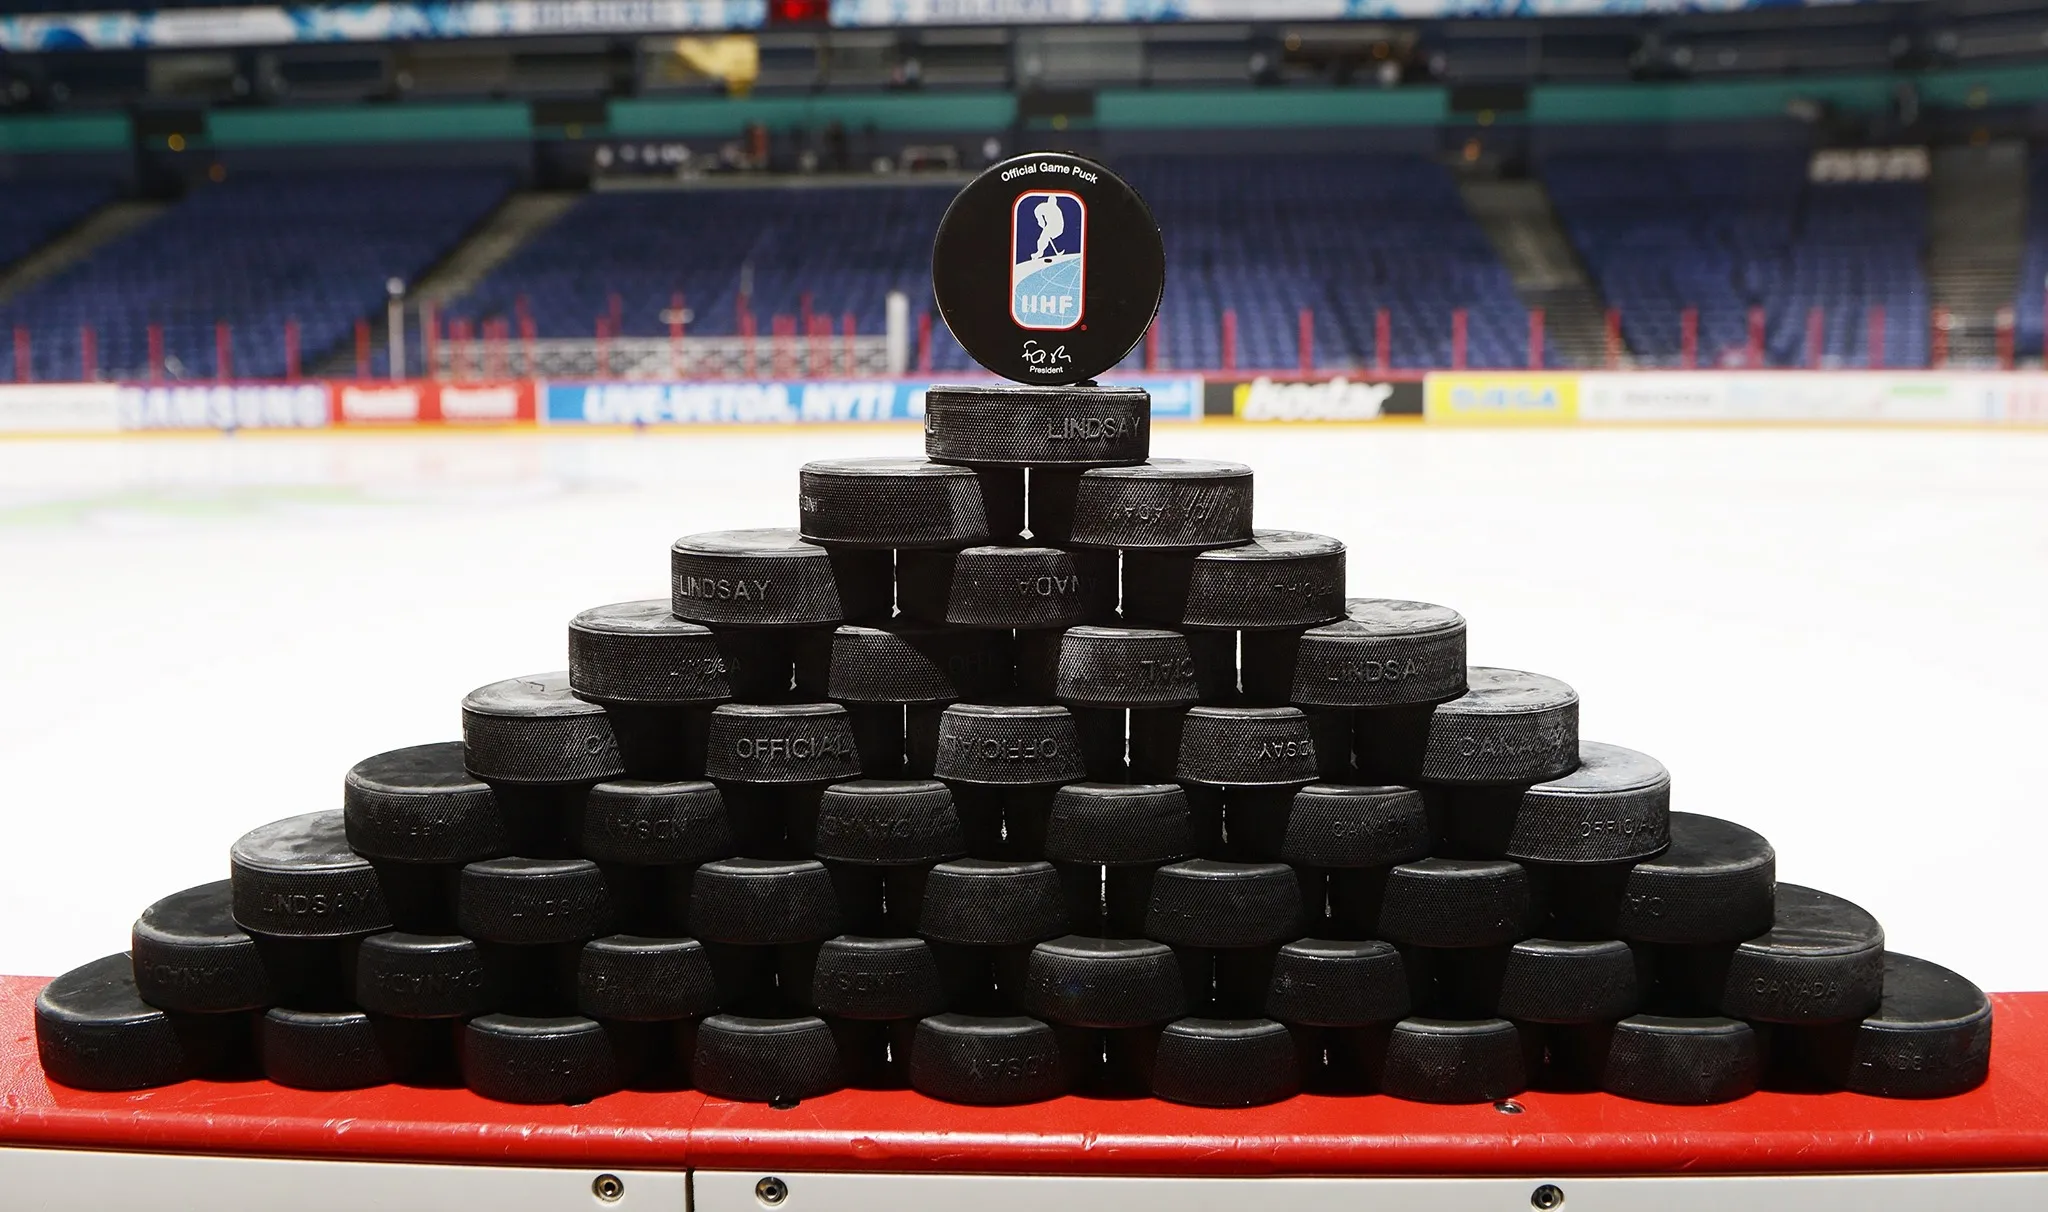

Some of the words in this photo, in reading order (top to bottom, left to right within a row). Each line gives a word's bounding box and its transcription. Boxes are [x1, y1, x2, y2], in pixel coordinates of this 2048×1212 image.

[1001, 163, 1037, 182] Official
[1039, 162, 1070, 175] Game
[1072, 166, 1099, 184] Puck
[1021, 295, 1073, 314] IIHF
[1029, 366, 1064, 374] President
[1047, 416, 1142, 439] LINDSAY
[679, 575, 771, 600] LINDSAY
[736, 735, 850, 759] OFFICIAL
[946, 735, 1058, 759] OFFICIAL
[260, 888, 373, 916] LINDSAY
